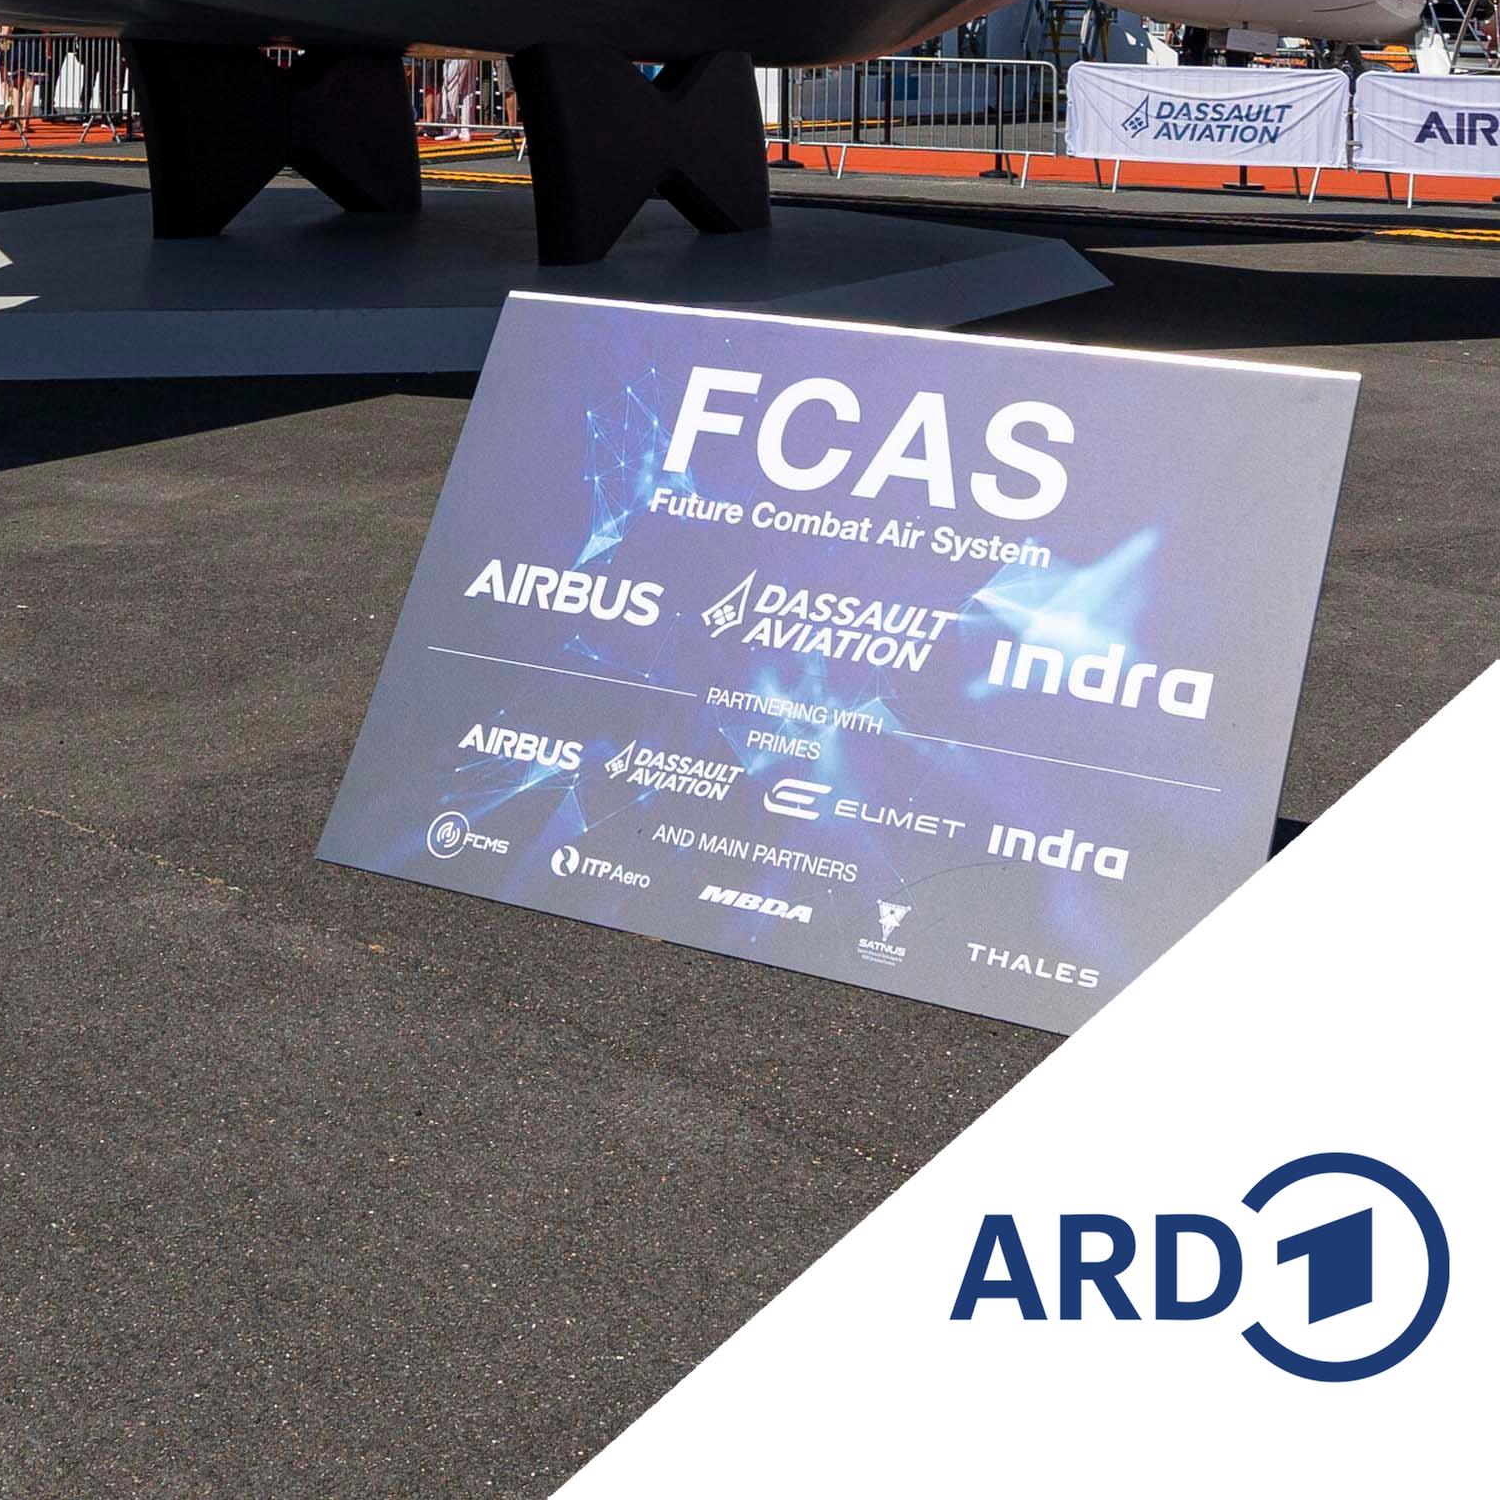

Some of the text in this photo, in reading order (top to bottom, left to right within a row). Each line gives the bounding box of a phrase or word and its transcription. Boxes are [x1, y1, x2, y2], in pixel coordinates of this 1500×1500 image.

[1153, 121, 1281, 144] AVIATION
[1155, 100, 1293, 124] DASSAULT
[662, 366, 1075, 520] FCAS
[650, 488, 1051, 568] Future Combat Air System
[464, 559, 664, 626] AIRBUS
[753, 584, 959, 641] DASSAULT
[738, 617, 933, 672] AVIATION
[987, 639, 1214, 720] indra
[706, 687, 884, 735] PARTNERING WITH
[458, 723, 583, 770] AIRBUS
[634, 748, 745, 784] DASSAULT
[746, 730, 821, 760] PRIMES
[626, 767, 730, 801] AVIATION
[834, 799, 966, 838] EUMET
[462, 832, 510, 854] FCMS
[651, 824, 858, 882] AND MAIN PARTNERS
[987, 824, 1129, 880] indra
[698, 885, 813, 923] MBDA
[858, 938, 906, 957] SATNUS
[967, 942, 1100, 988] THALES
